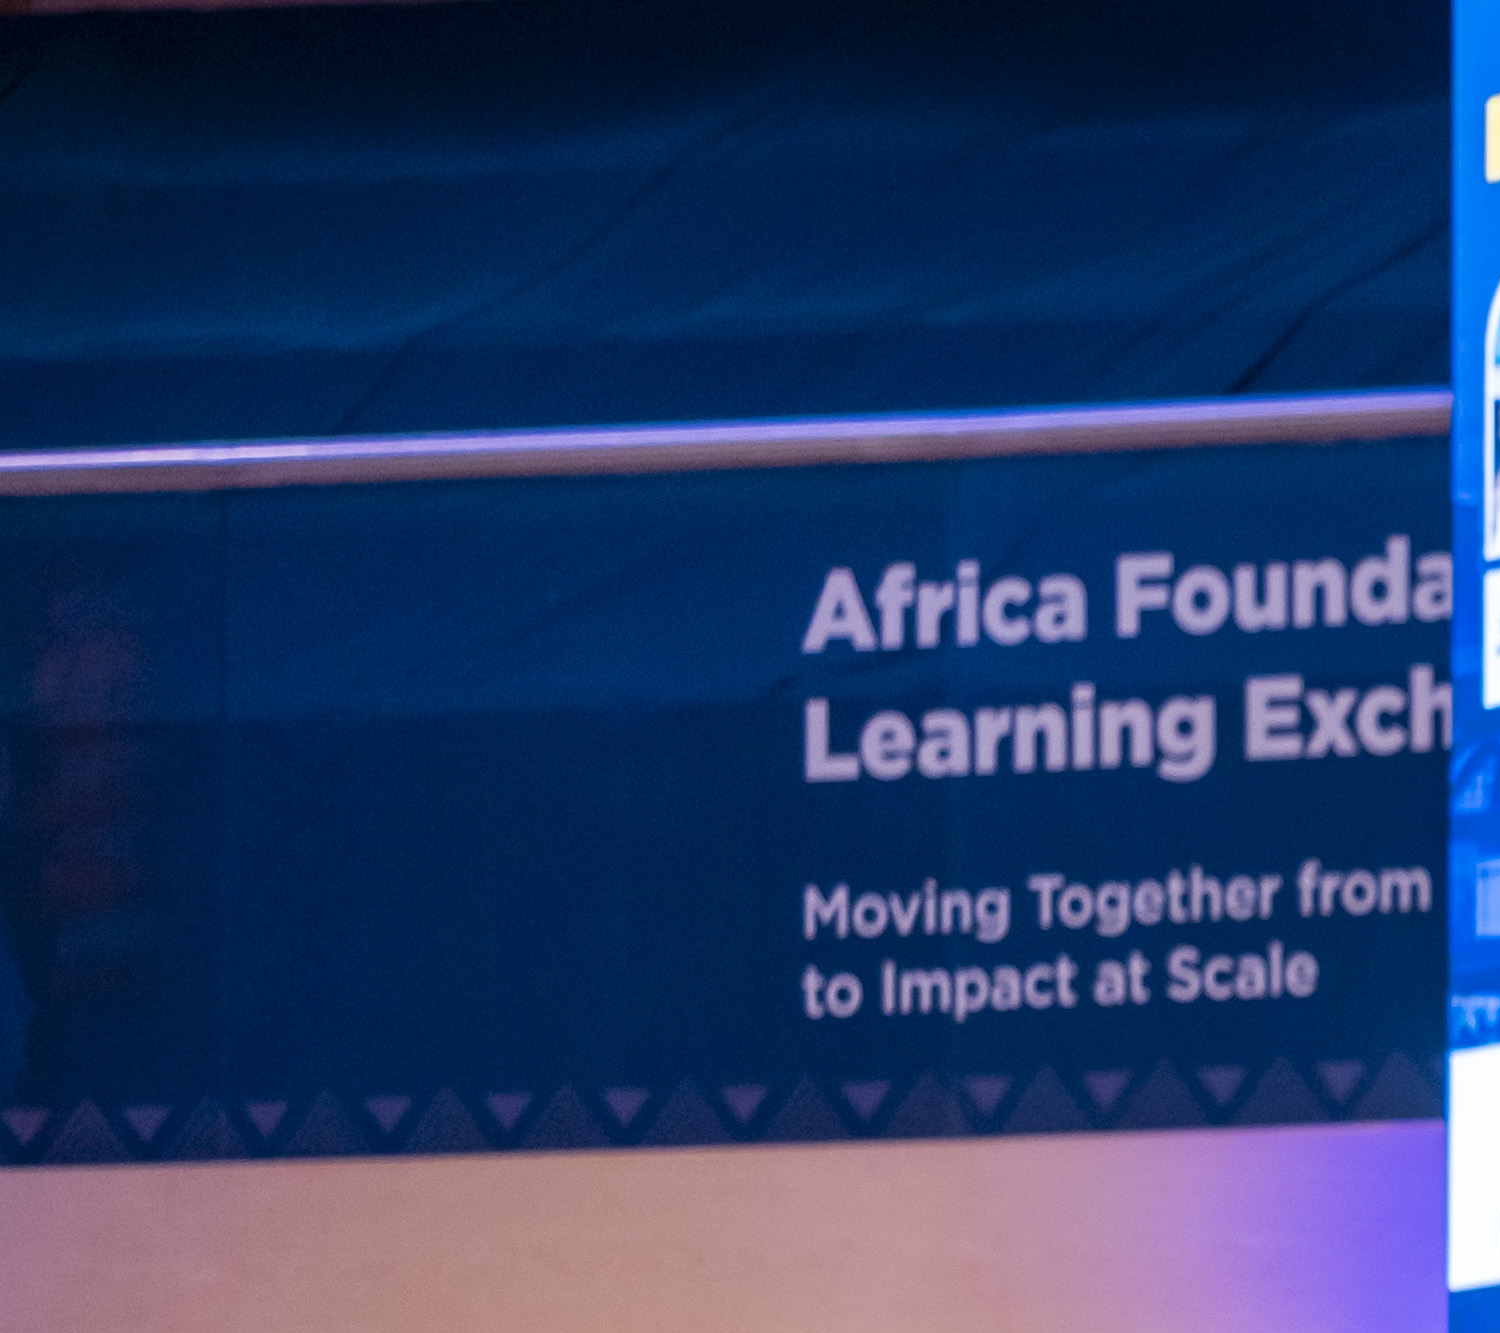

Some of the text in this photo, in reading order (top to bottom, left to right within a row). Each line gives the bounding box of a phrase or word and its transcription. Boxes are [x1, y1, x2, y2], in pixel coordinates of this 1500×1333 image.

[802, 535, 1453, 653] Africa Founda
[803, 663, 1453, 783] Learning Exch
[802, 858, 1432, 943] Moving Together from
[802, 940, 1319, 1023] to Impact at Scale
